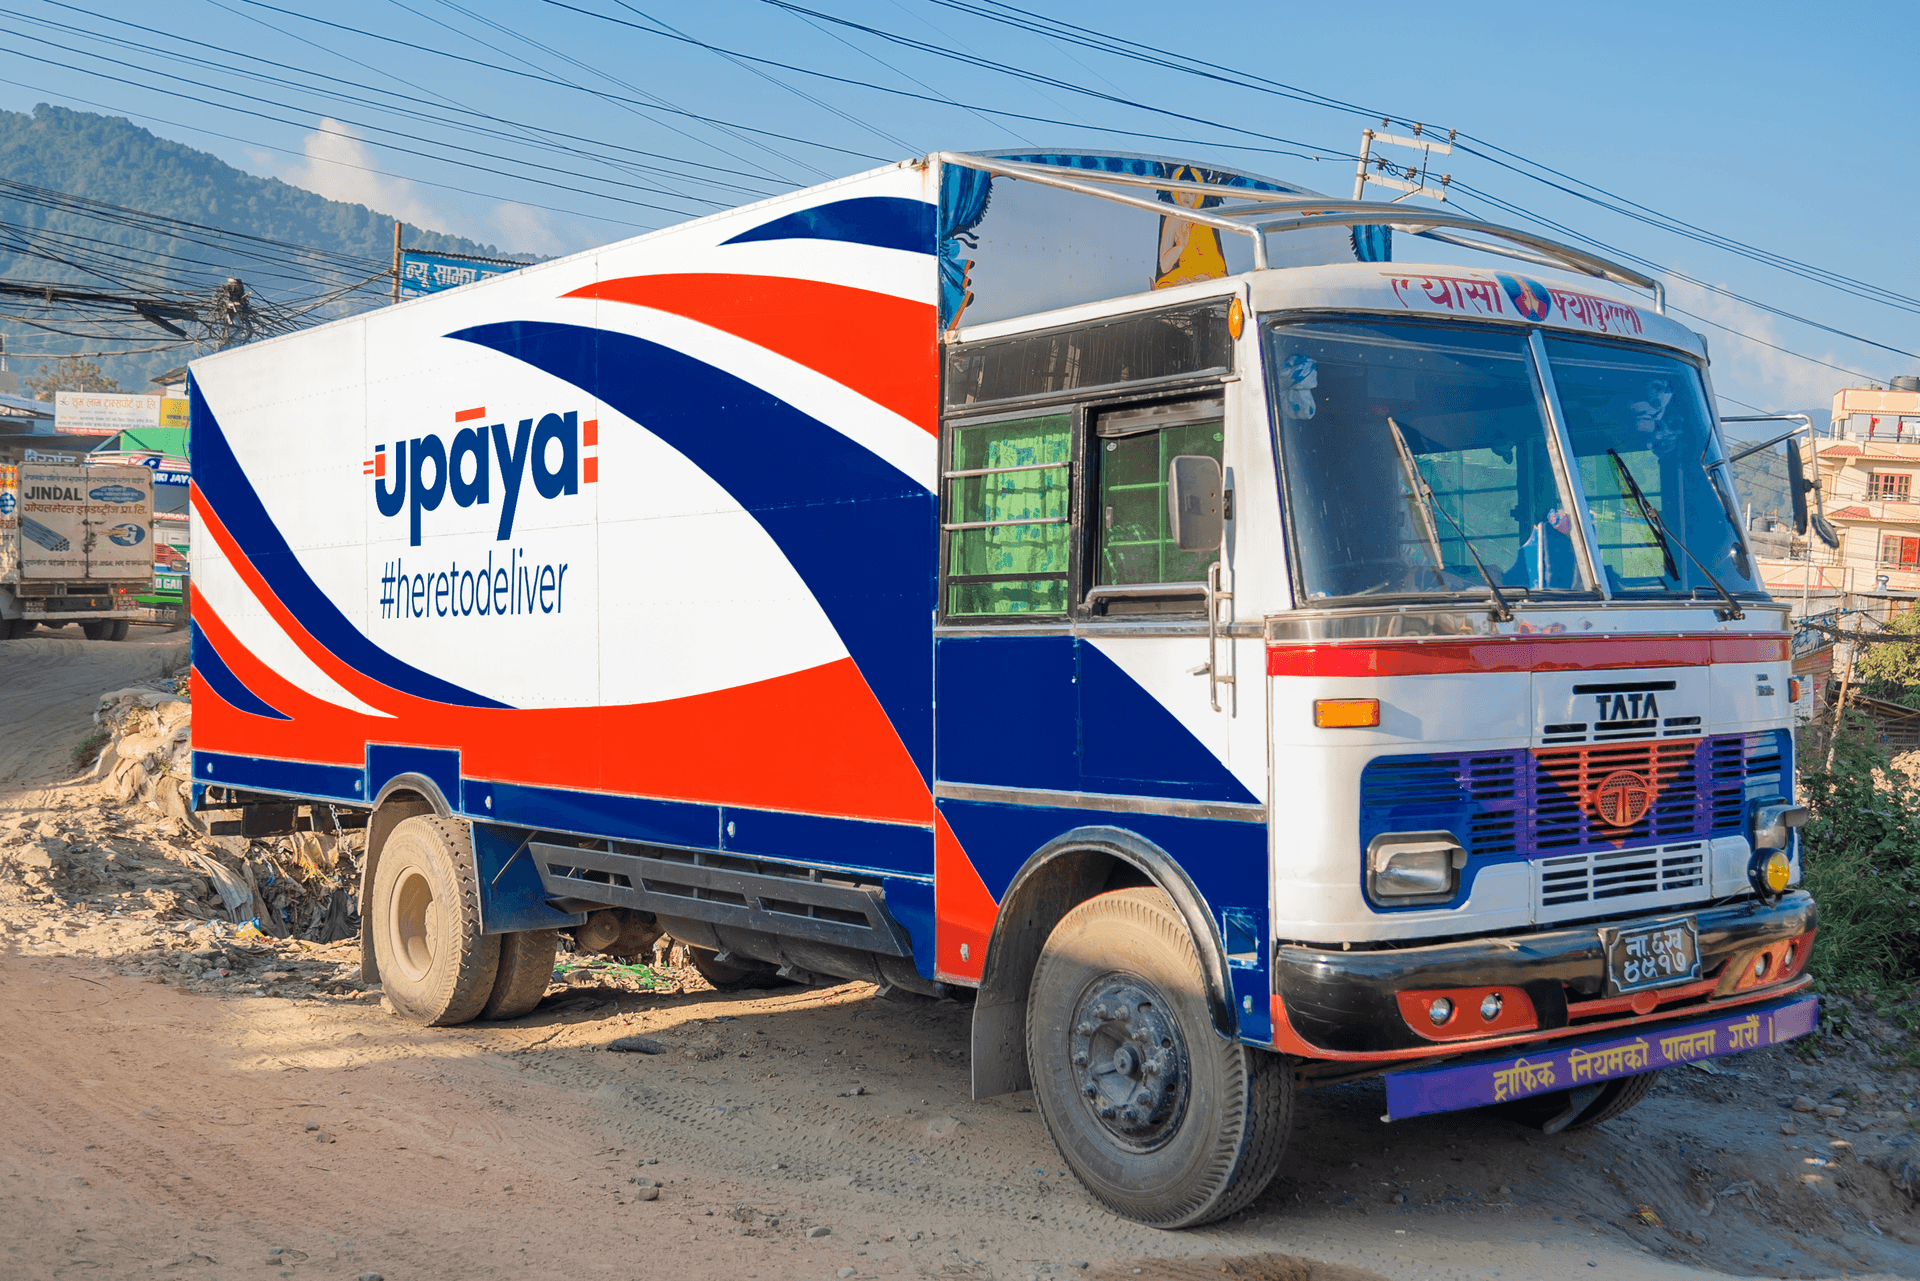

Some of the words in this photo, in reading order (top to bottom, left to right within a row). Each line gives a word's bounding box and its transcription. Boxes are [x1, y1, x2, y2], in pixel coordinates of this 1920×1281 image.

[24, 486, 83, 501] JINDAL
[380, 547, 568, 619] #heretodeliver
[1596, 693, 1659, 721] TATA
[1493, 1058, 1556, 1101] ट्राफिक
[1568, 1036, 1650, 1083] नियमको
[1660, 1029, 1716, 1064] पालना
